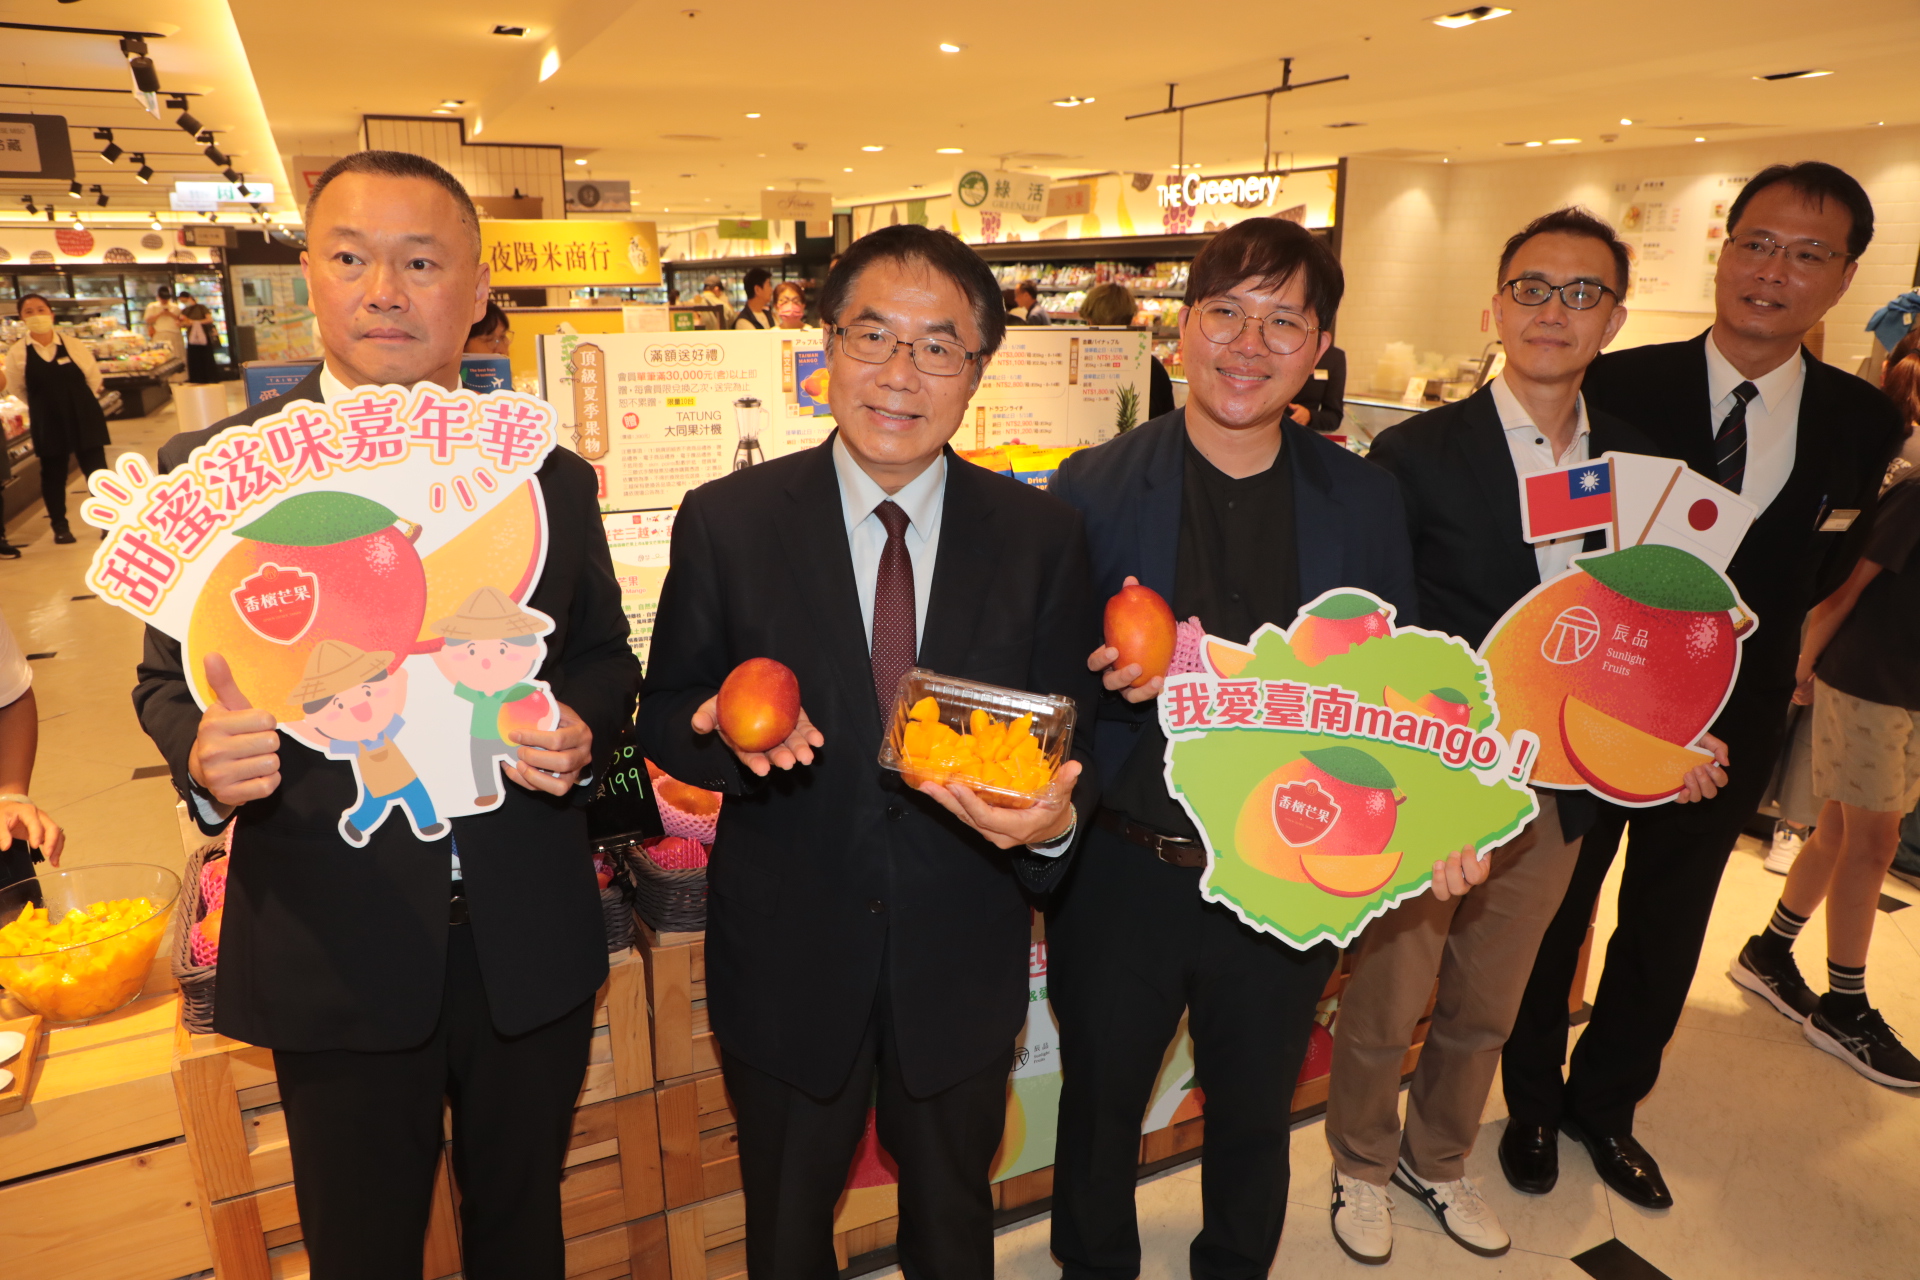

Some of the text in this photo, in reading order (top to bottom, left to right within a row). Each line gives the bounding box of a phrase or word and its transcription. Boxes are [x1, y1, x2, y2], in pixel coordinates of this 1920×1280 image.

[1157, 173, 1281, 207] THE Greenery
[488, 240, 611, 274] 夜陽米商行
[650, 348, 718, 363] 滿額送好禮
[580, 350, 602, 454] 頂級夏季果物
[624, 414, 638, 428] 贈
[676, 410, 722, 422] TATUNG
[664, 424, 722, 437] 大同果汁機
[100, 395, 545, 608] 甜蜜滋味嘉年華
[617, 575, 639, 588] 芒果
[243, 585, 312, 613] 香檳芒果
[1606, 647, 1647, 666] Sunlight
[1602, 660, 1631, 677] Fruits
[608, 767, 644, 800] 199
[1278, 794, 1331, 824] 香檳芒果
[1033, 1050, 1050, 1059] Sunlight
